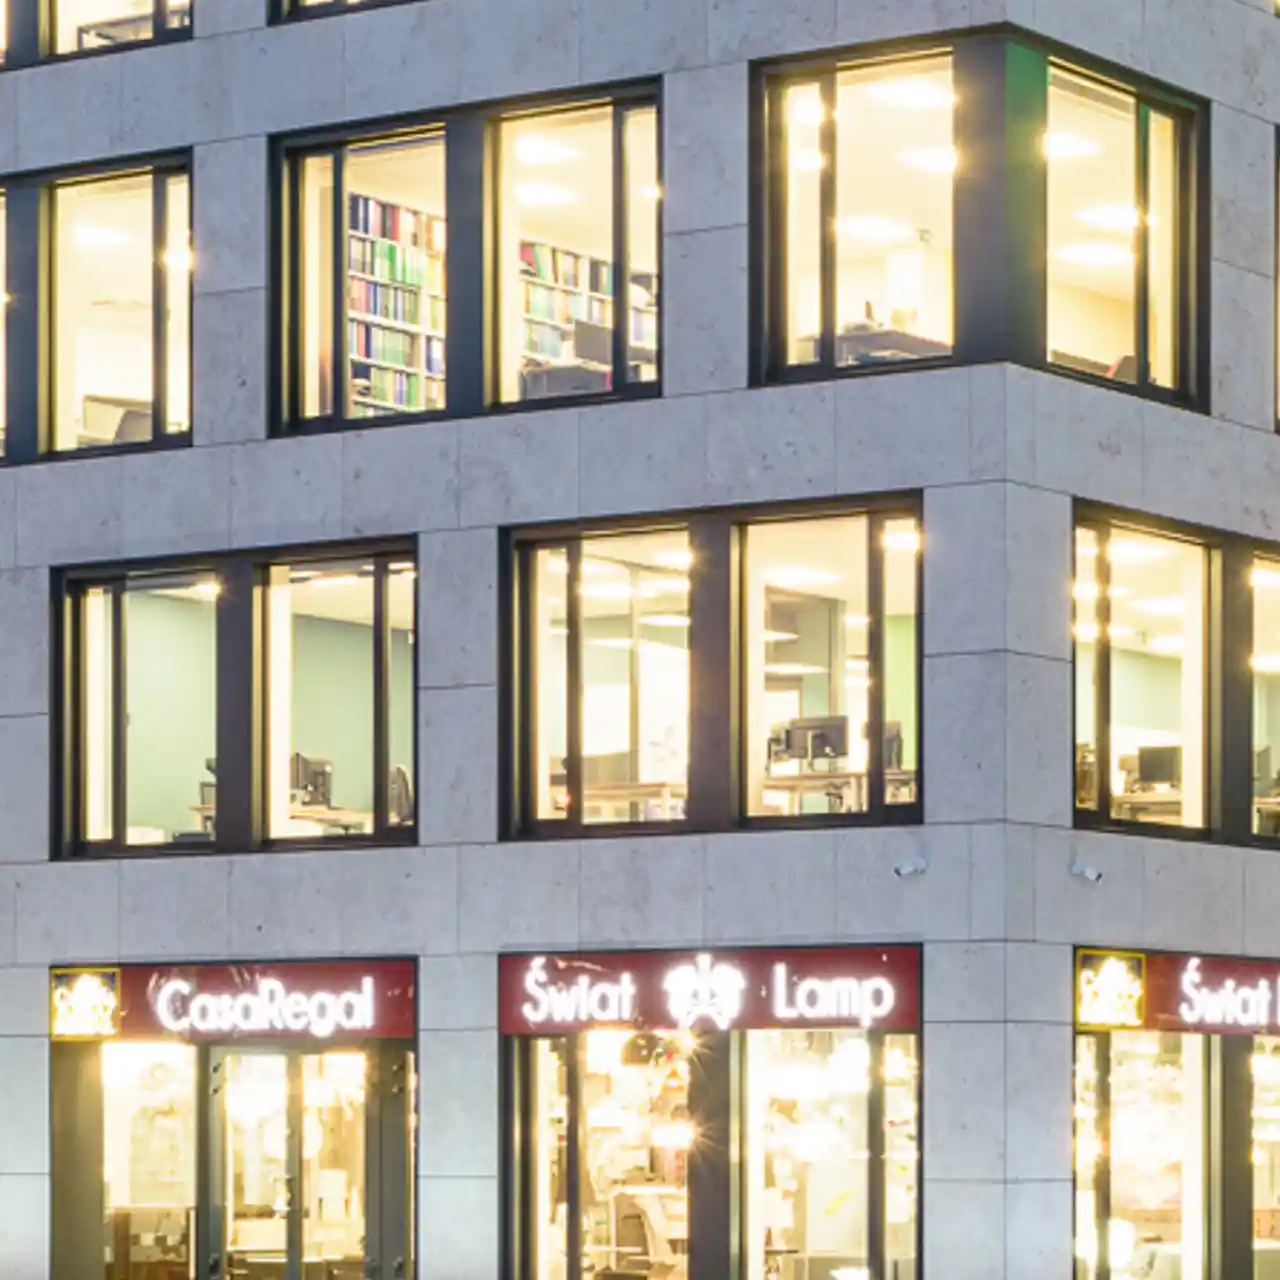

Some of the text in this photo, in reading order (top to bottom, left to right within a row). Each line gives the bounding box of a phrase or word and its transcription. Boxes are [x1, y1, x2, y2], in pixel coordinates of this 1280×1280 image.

[521, 955, 896, 1027] Świat Lamp
[1178, 956, 1272, 1025] Świat
